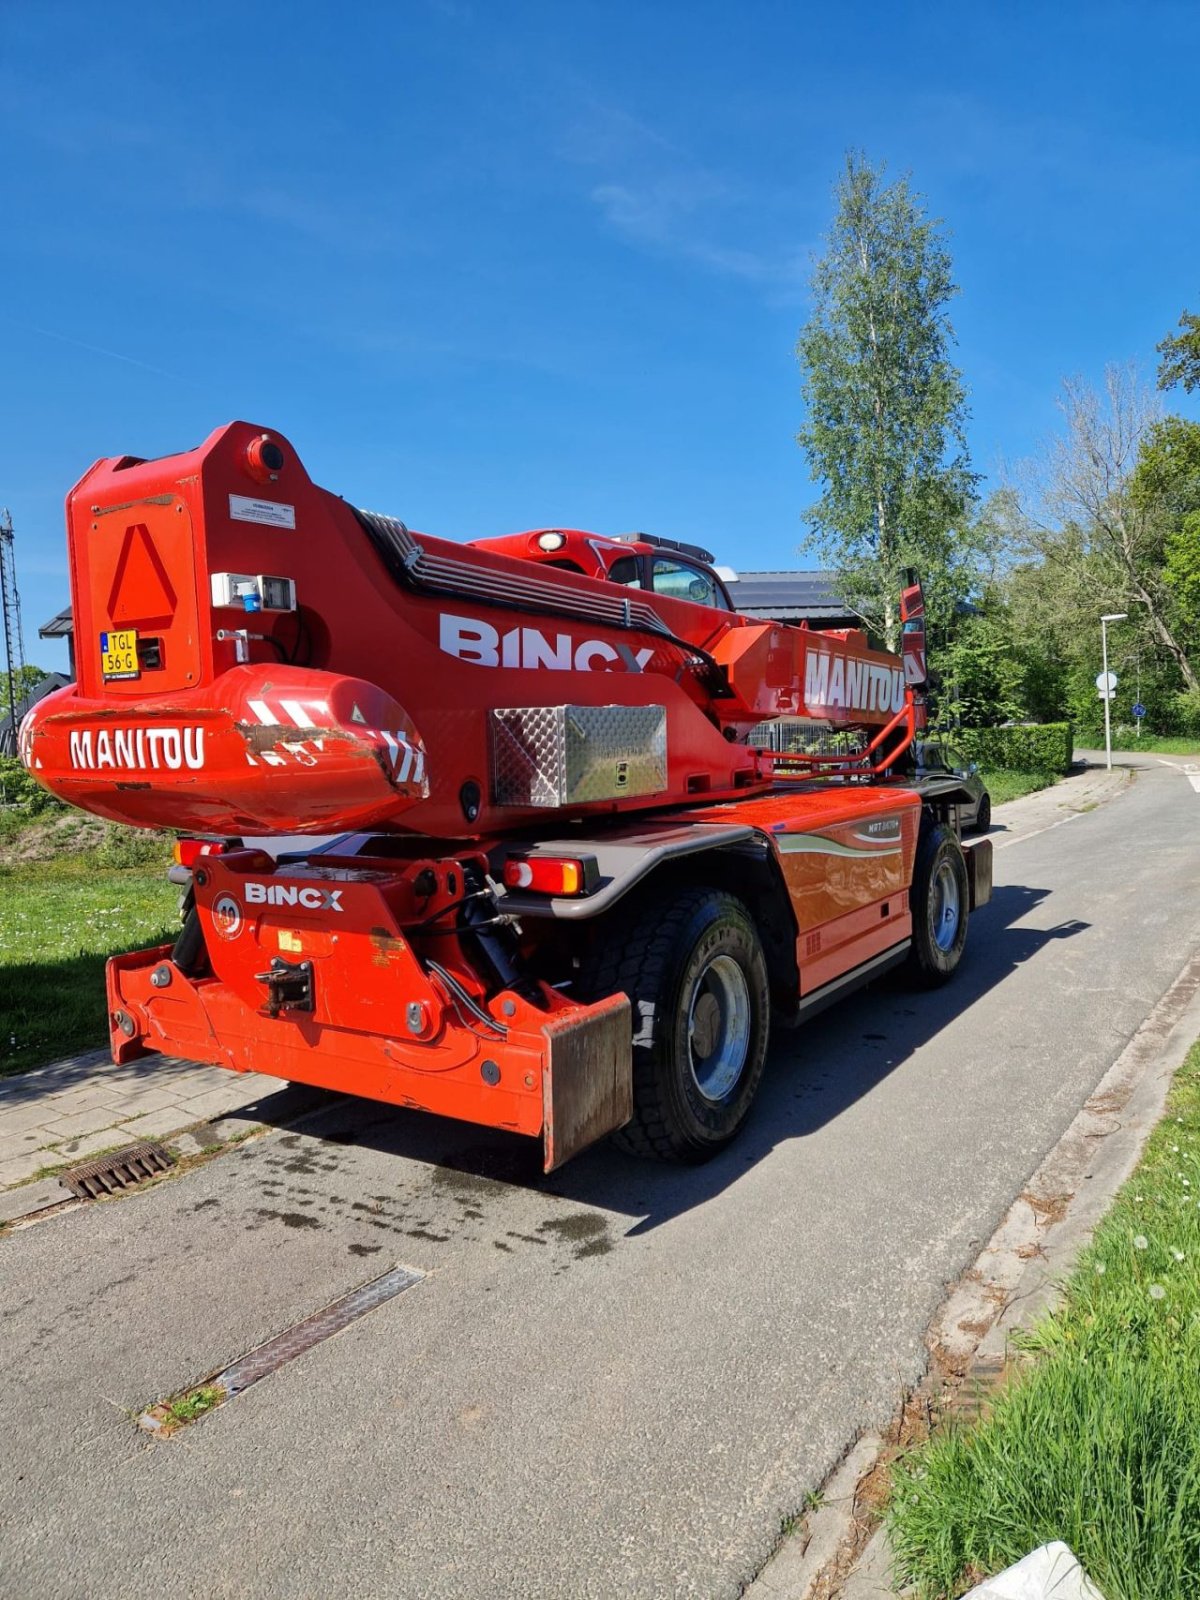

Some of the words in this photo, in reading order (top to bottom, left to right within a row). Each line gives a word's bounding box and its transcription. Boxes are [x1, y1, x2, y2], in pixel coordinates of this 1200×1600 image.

[111, 634, 132, 651] TGL
[804, 649, 905, 714] MANITOU
[69, 726, 204, 770] MANITOU
[245, 882, 344, 912] BINCX
